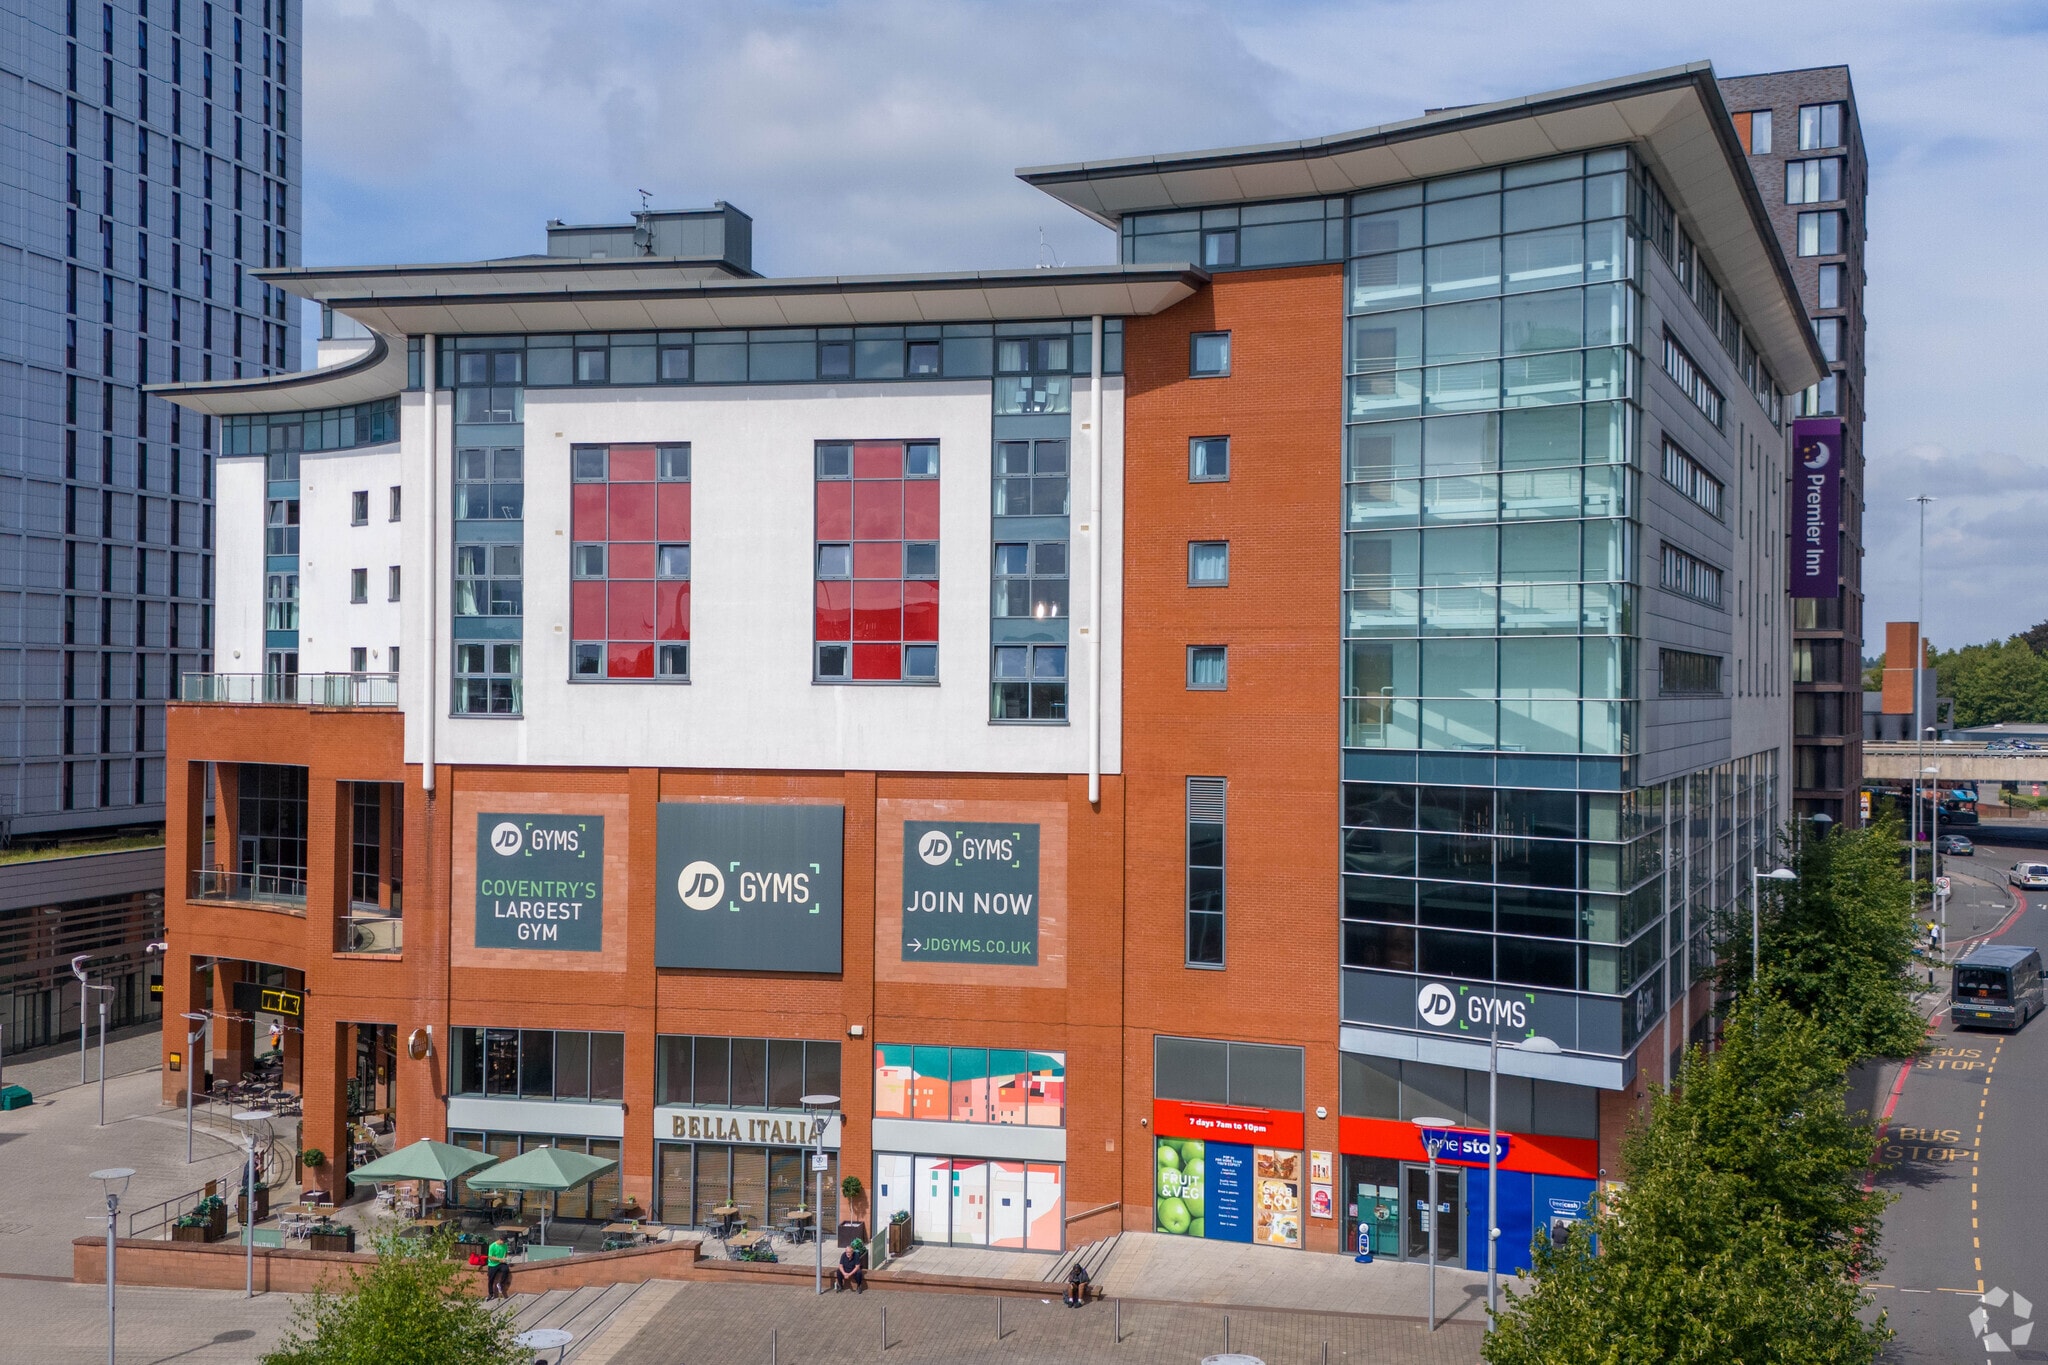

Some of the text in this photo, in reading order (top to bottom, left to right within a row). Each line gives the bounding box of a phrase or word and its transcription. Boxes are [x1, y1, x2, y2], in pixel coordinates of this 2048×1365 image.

[1806, 474, 1826, 576] Premier Inn
[495, 829, 579, 851] JD GYMS
[923, 838, 1013, 861] JD GYMS
[481, 879, 597, 899] COVENTRY'S
[685, 871, 810, 904] JD GYMS
[494, 901, 583, 921] LARGEST
[906, 890, 1033, 915] JOIN NOW
[517, 924, 558, 941] GYM
[922, 938, 1032, 955] JDGYMS.CO.UK
[1423, 993, 1526, 1028] JD GYMS
[1930, 1047, 1983, 1059] BUS
[1916, 1060, 1986, 1070] STOP
[672, 1115, 819, 1144] BELLA ITALIA
[1196, 1118, 1214, 1128] days
[1216, 1120, 1232, 1129] 7am
[1244, 1123, 1267, 1133] 10pm
[1899, 1127, 1961, 1143] BUS
[1884, 1145, 1970, 1161] STOP
[1162, 1172, 1200, 1187] FRUIT
[1263, 1184, 1293, 1197] GRAB
[1273, 1195, 1292, 1207] GO
